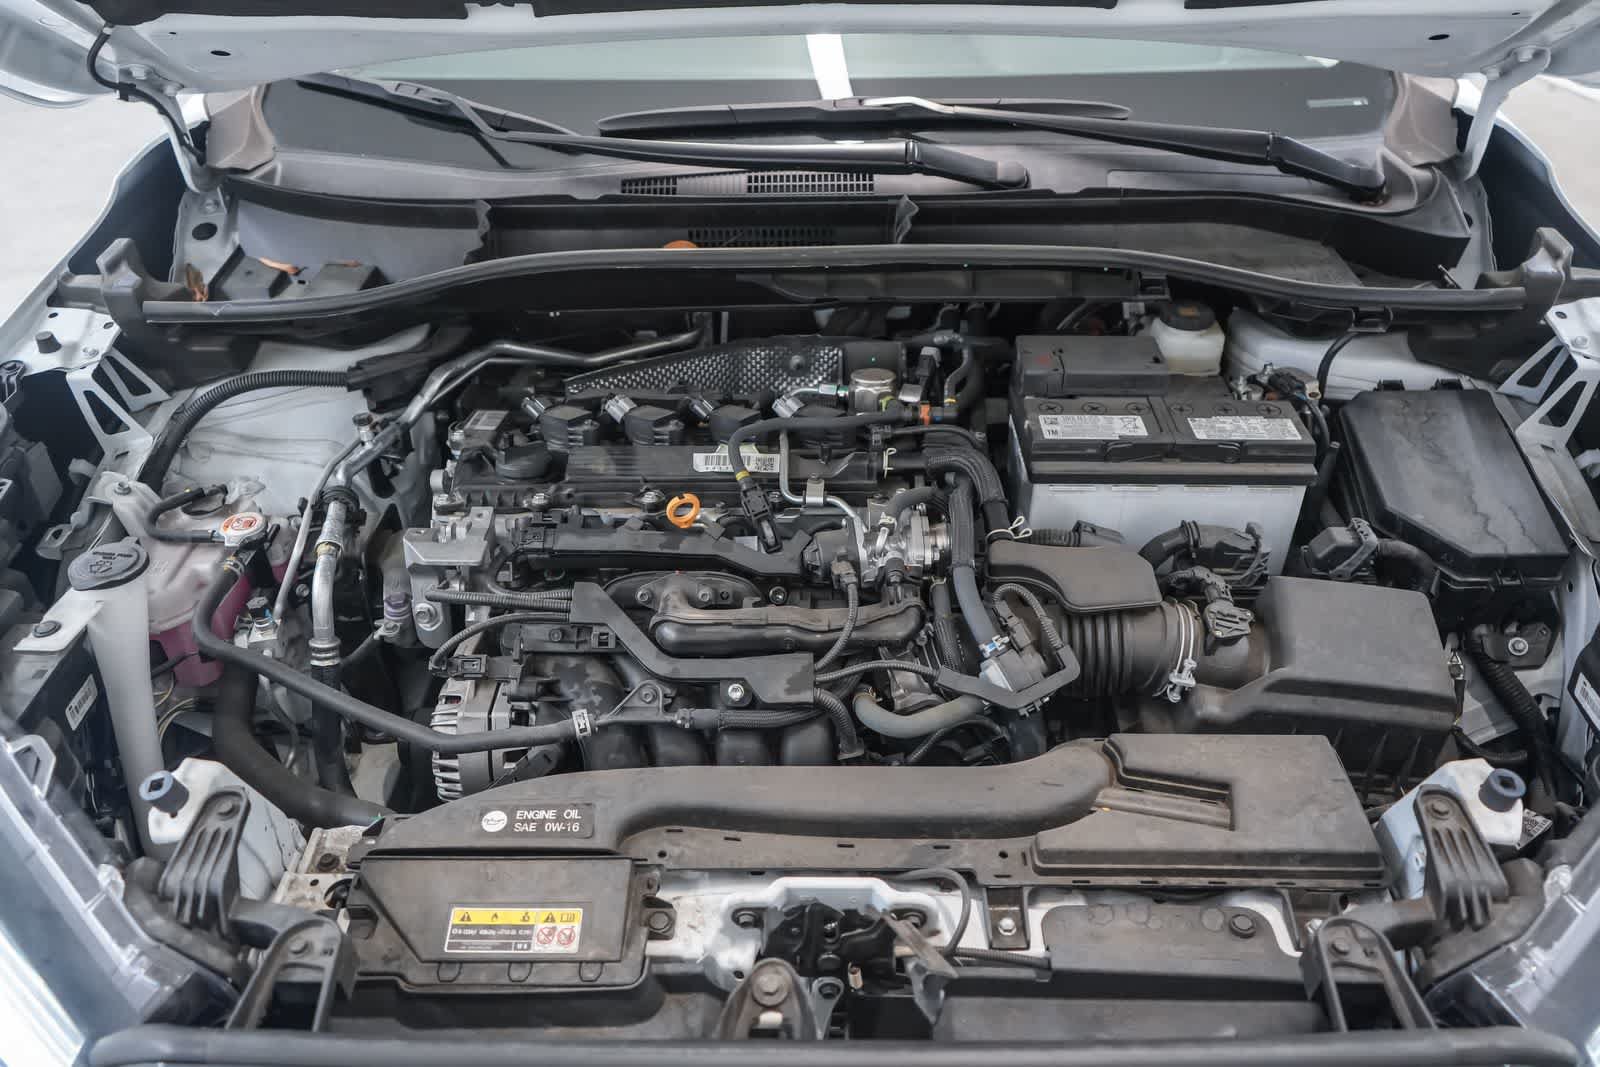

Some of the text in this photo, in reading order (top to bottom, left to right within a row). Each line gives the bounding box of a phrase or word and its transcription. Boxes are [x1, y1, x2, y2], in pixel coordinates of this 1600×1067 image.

[516, 808, 582, 820] ENGINE OIL
[513, 822, 580, 832] SAE 0W-16
